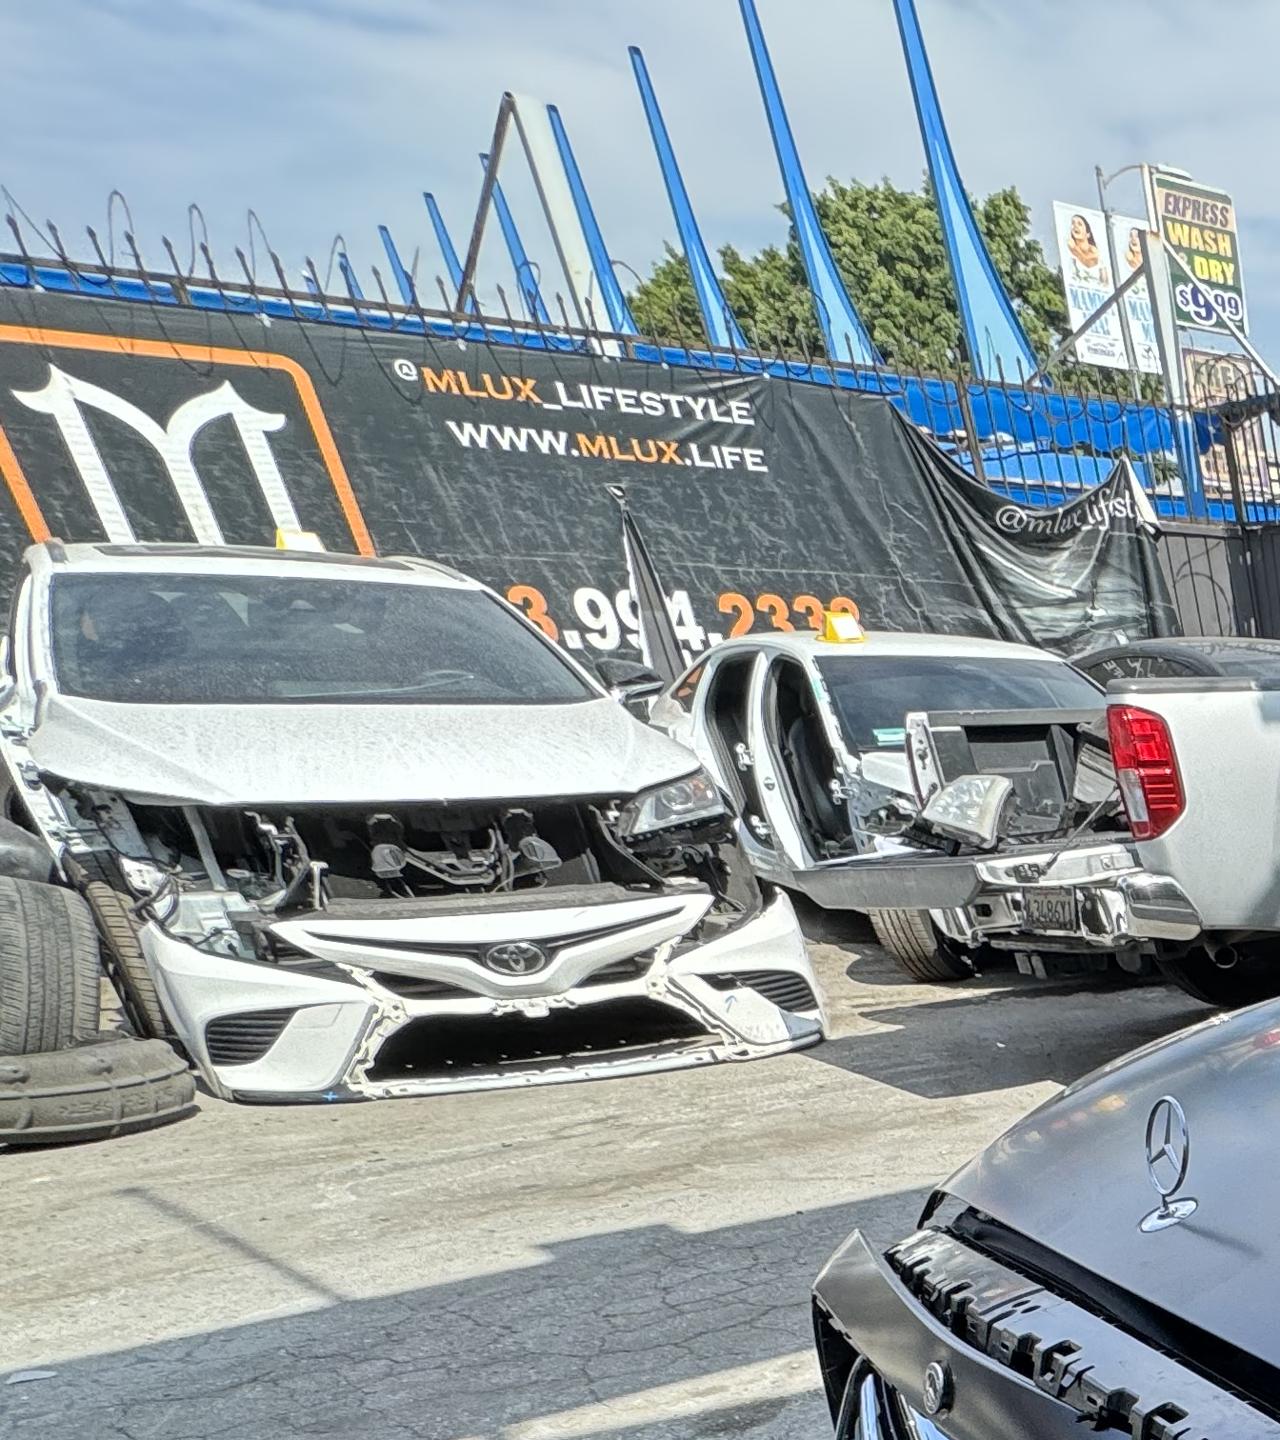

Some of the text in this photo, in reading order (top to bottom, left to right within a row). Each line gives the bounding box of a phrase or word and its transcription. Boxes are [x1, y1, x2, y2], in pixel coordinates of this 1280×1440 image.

[1164, 192, 1229, 228] EXPRESS
[1166, 220, 1233, 258] WASH
[1193, 254, 1235, 286] DRY
[446, 420, 769, 472] WWW.MLUX.LIFE
